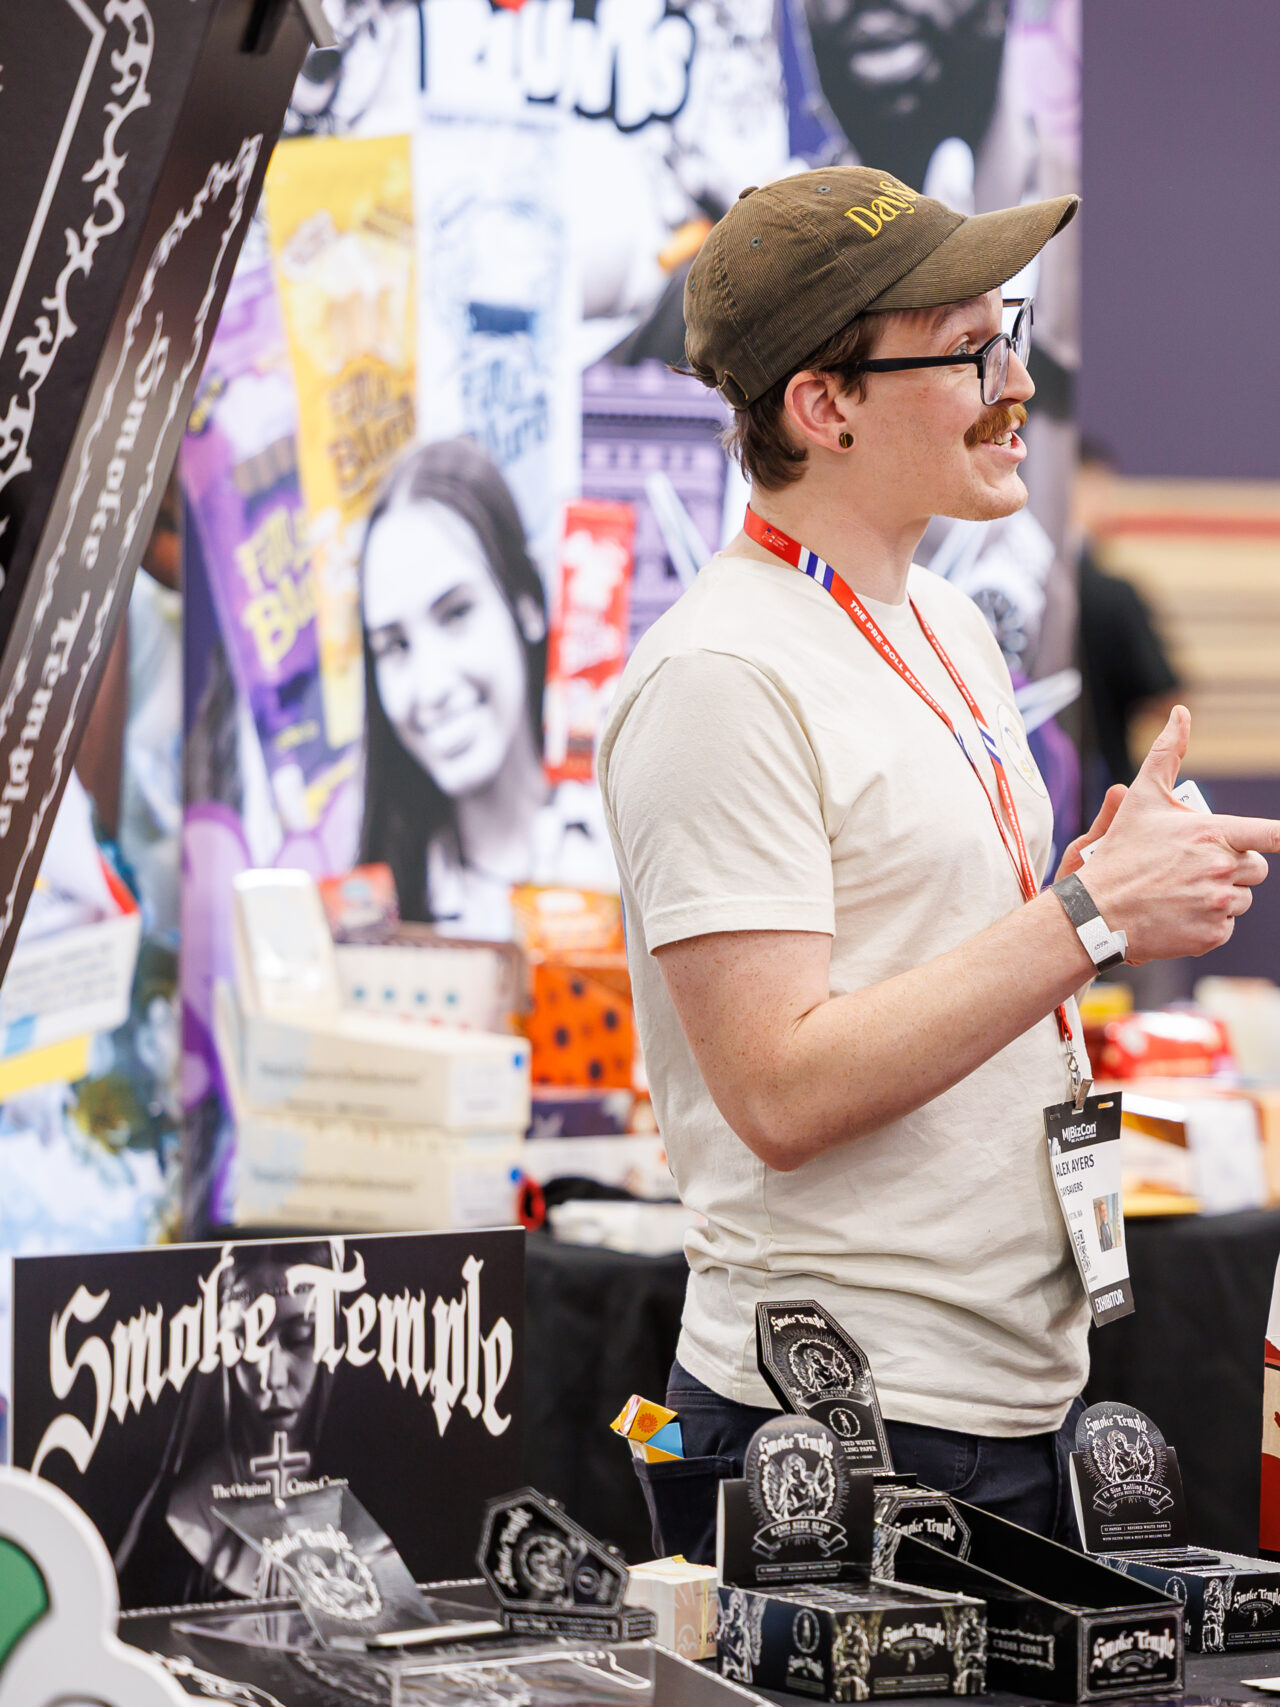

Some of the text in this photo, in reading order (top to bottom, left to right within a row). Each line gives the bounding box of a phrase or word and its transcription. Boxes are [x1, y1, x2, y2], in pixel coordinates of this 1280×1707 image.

[850, 599, 867, 620] THE
[865, 618, 904, 671] PRE-ROLL
[1055, 1154, 1095, 1178] ALEX AYERS
[1094, 1289, 1125, 1314] EXHIBITOR
[770, 1313, 828, 1333] Smoke Temple
[31, 1244, 276, 1477] Smoke
[1085, 1414, 1148, 1440] Smoke Temple
[758, 1432, 834, 1466] Smoke Temple
[211, 1480, 271, 1499] The Original
[1123, 1483, 1142, 1492] Rolling
[1144, 1484, 1162, 1496] Papers
[769, 1520, 831, 1537] KING SIZE SLIM
[1231, 1587, 1258, 1612] Smoke
[1090, 1627, 1176, 1674] Smoke Temple
